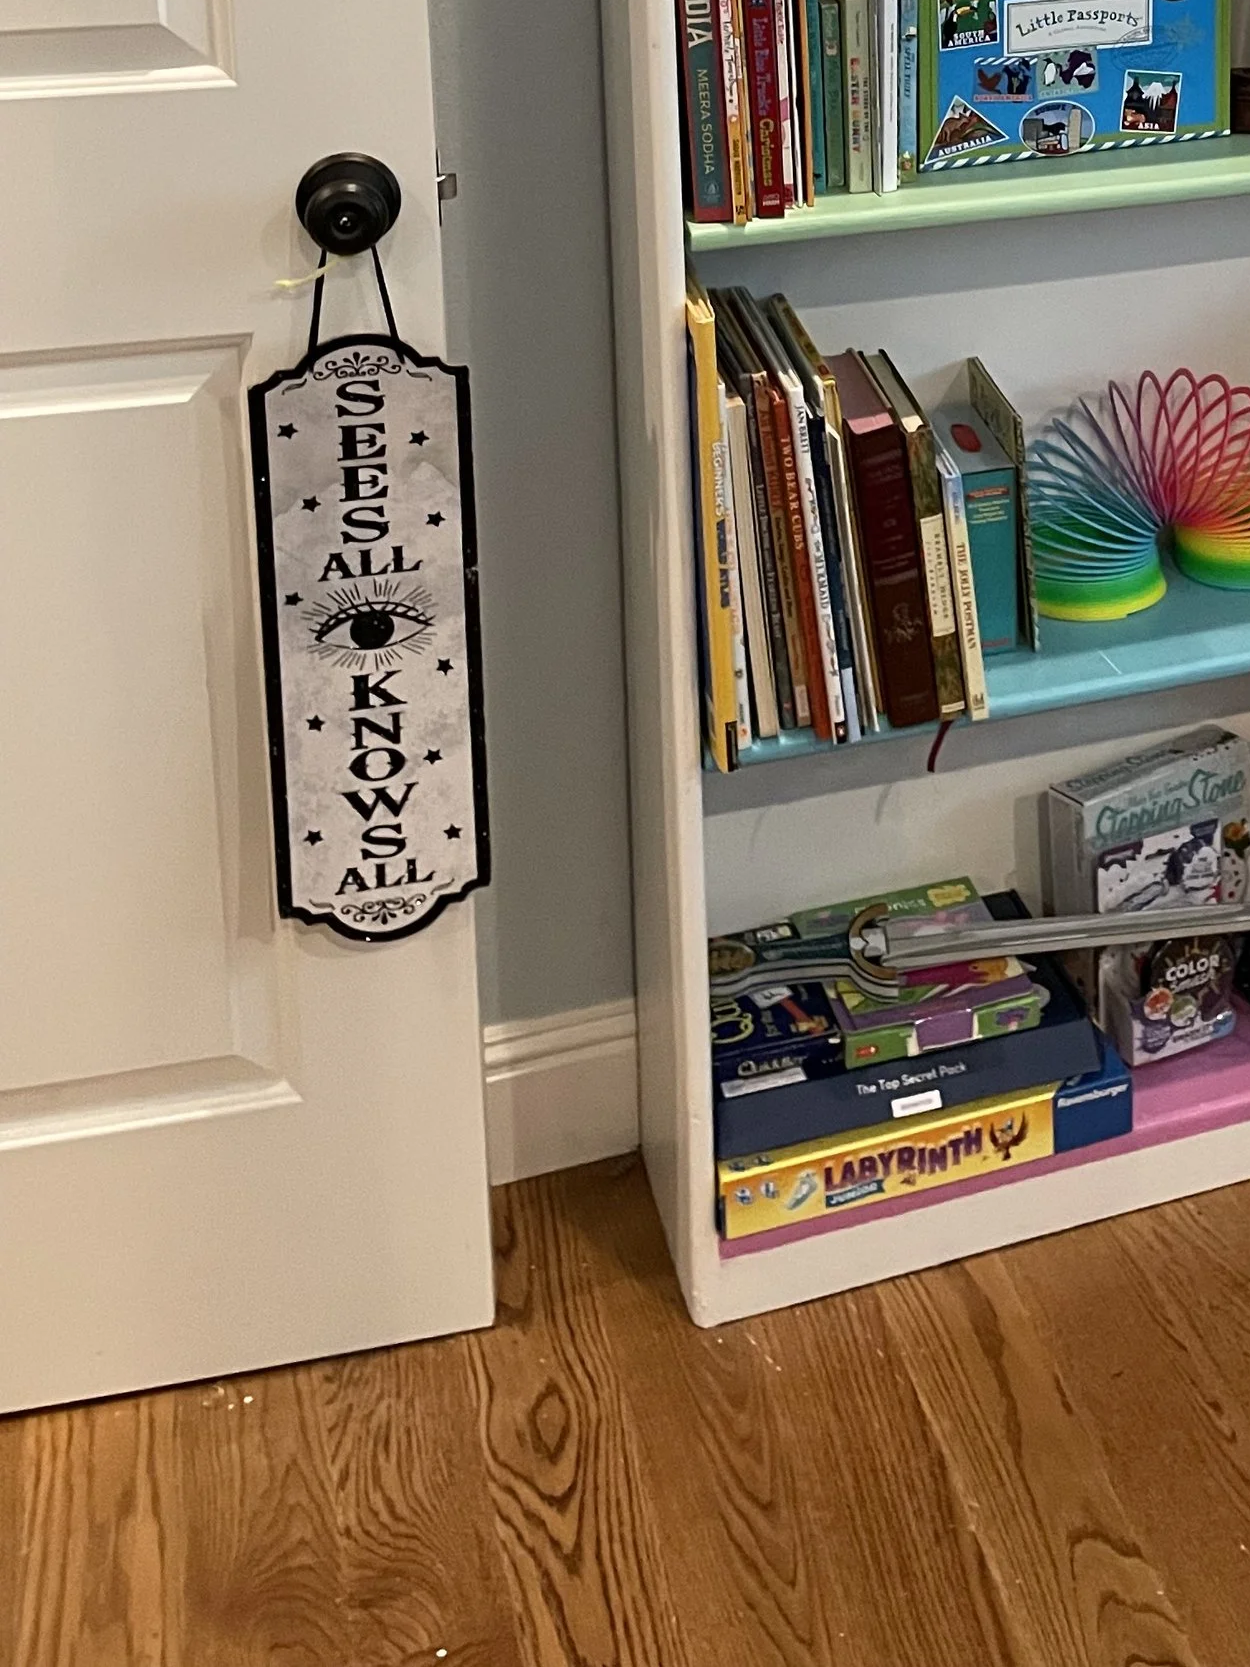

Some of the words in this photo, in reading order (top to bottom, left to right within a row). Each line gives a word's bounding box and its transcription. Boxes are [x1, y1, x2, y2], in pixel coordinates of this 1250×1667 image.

[752, 16, 769, 47] Little
[947, 35, 991, 47] AMERICA
[953, 30, 985, 40] SOUTH
[1016, 11, 1064, 38] Little
[1066, 9, 1142, 28] Passports
[755, 48, 770, 73] Blue
[695, 68, 711, 119] MEERA
[756, 74, 771, 116] Truck's
[850, 57, 861, 106] EASTER
[850, 110, 861, 154] BUNNY
[1137, 122, 1160, 130] ASIA
[701, 122, 714, 175] SODHA
[758, 117, 775, 187] Christmas
[937, 135, 992, 157] AUSTRALIA
[795, 406, 805, 425] JAN
[780, 435, 793, 468] TWO
[798, 426, 809, 454] BRETT
[334, 379, 390, 545] SEES
[711, 441, 727, 516] BEGINNER'S
[755, 484, 766, 515] LITTLE
[784, 471, 799, 510] BEAR
[790, 514, 804, 551] CUBS
[317, 545, 424, 582] ALL
[956, 542, 967, 567] THE
[814, 555, 830, 610] MERMAID
[957, 569, 970, 598] JOLLY
[962, 601, 976, 649] POSTMAN
[341, 669, 419, 860] KNOWS
[335, 858, 437, 896] ALL
[1165, 953, 1221, 982] COLOR
[856, 1082, 877, 1096] The
[878, 1078, 900, 1093] Top
[901, 1067, 938, 1087] Secret
[939, 1060, 967, 1078] Pack
[824, 1128, 984, 1192] LABYRINTH
